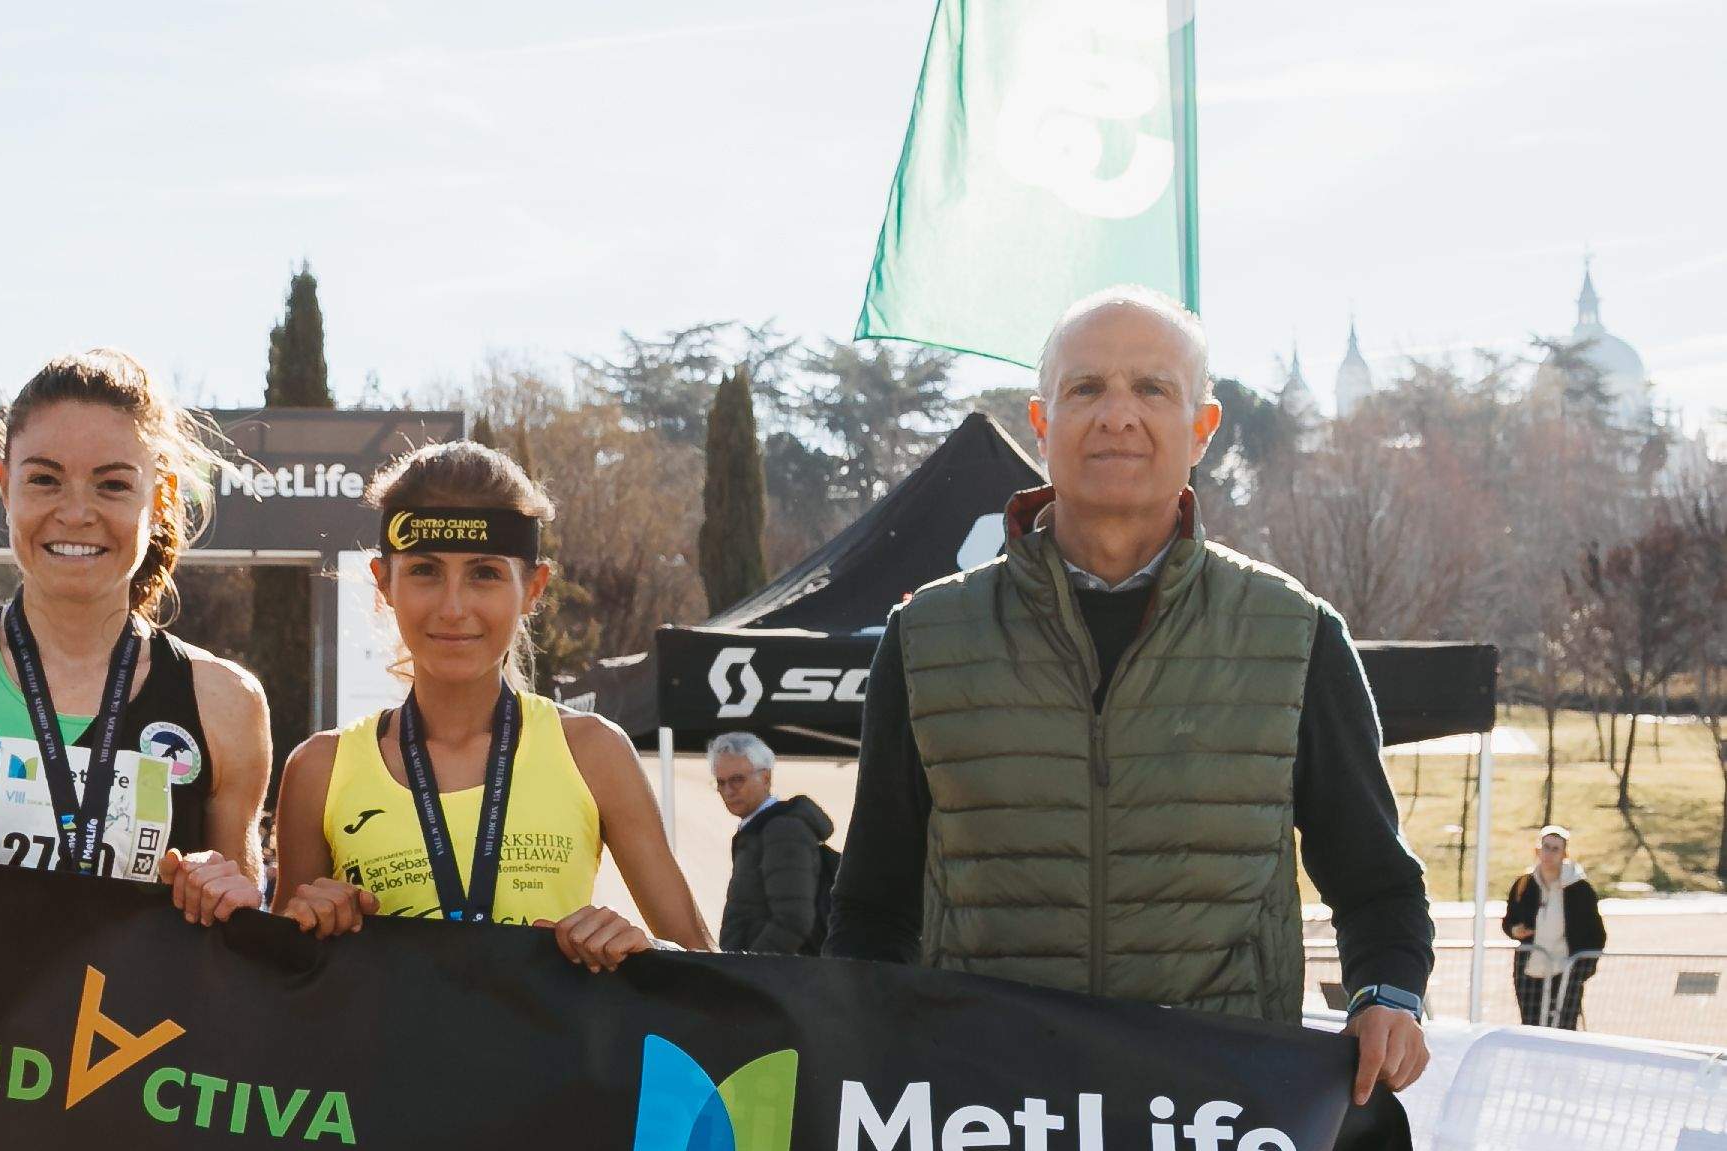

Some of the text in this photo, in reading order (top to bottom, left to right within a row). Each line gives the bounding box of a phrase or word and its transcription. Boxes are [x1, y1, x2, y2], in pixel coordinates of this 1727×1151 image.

[220, 463, 364, 498] MetLife
[410, 518, 487, 529] CENTRO CLINICO
[410, 529, 487, 541] MENORCA
[33, 697, 49, 729] MADRID
[42, 731, 57, 760] ACTIVA
[5, 790, 26, 804] VIII
[421, 791, 436, 824] MADRID
[430, 826, 444, 856] ACTIVA
[79, 817, 99, 860] MetLife
[502, 833, 574, 850] RKSHIRE
[502, 847, 570, 863] THAWAY
[366, 857, 431, 880] San Sebas
[370, 871, 435, 893] de los Reye
[512, 878, 544, 891] Spain
